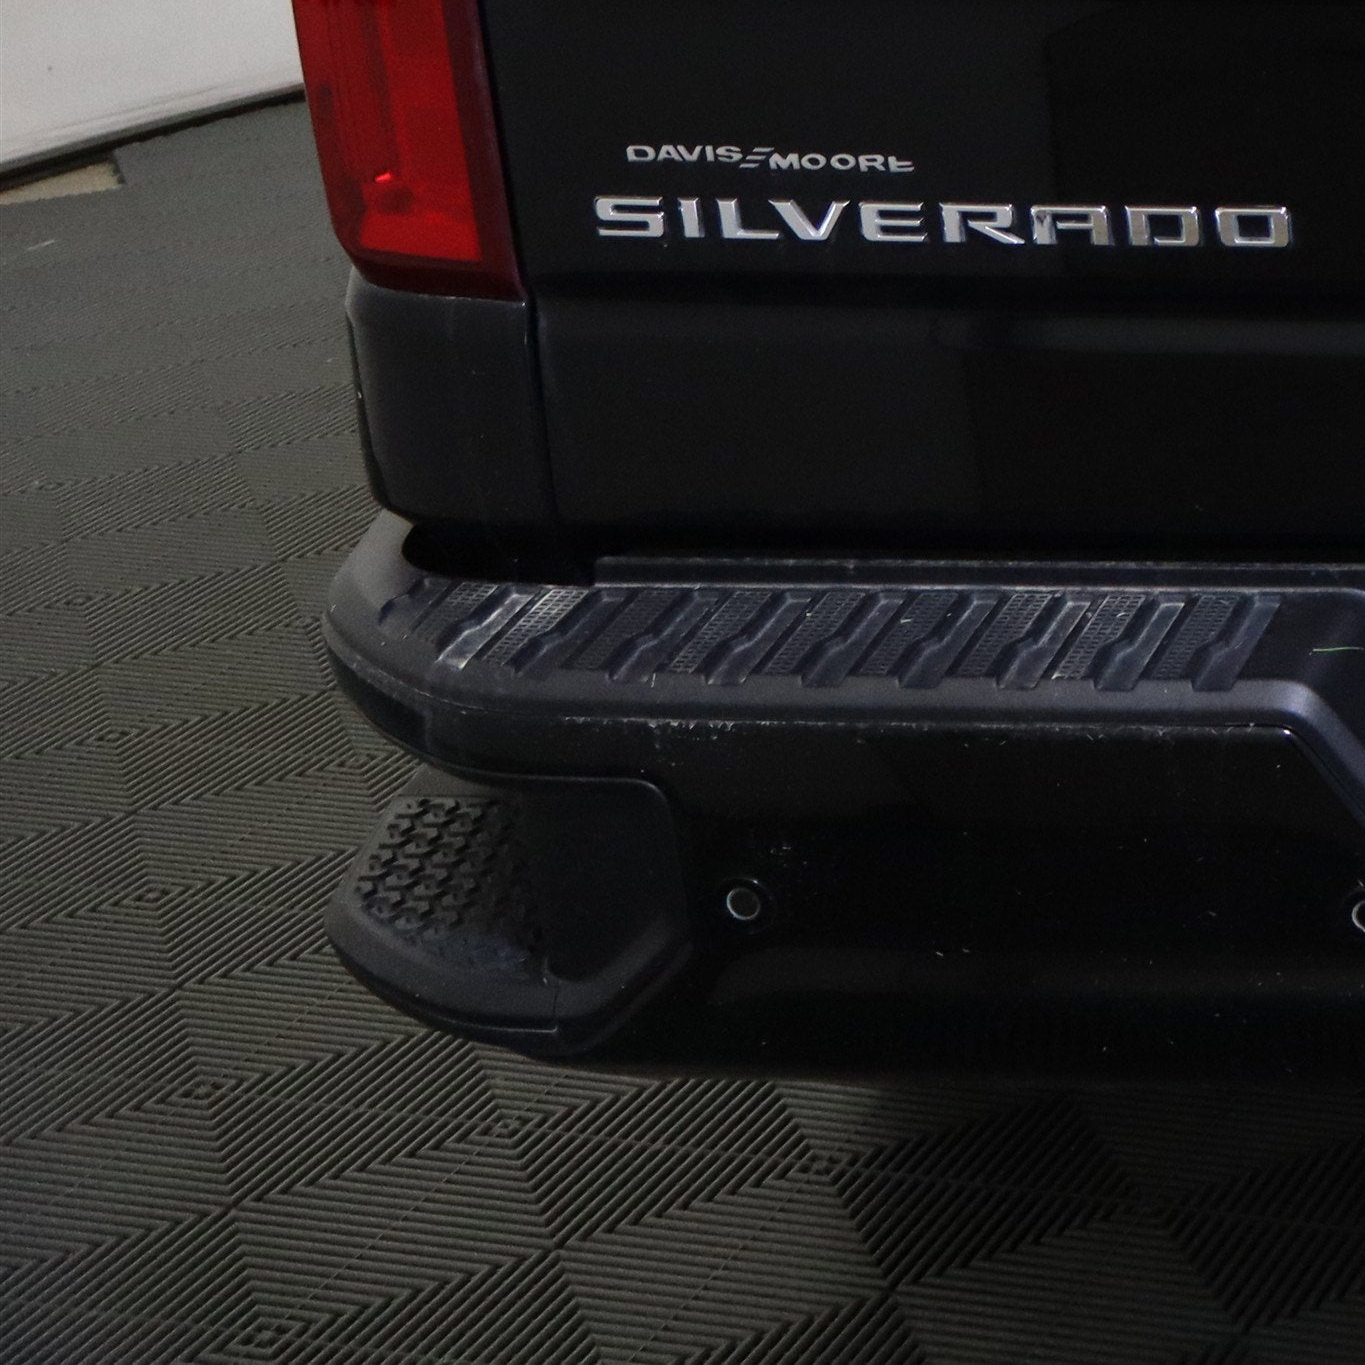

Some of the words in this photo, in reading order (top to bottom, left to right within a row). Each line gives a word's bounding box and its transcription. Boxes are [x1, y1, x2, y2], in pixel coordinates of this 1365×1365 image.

[626, 144, 743, 163] DAVIS
[768, 152, 915, 173] MOORE
[594, 195, 1292, 248] SILVERADO
